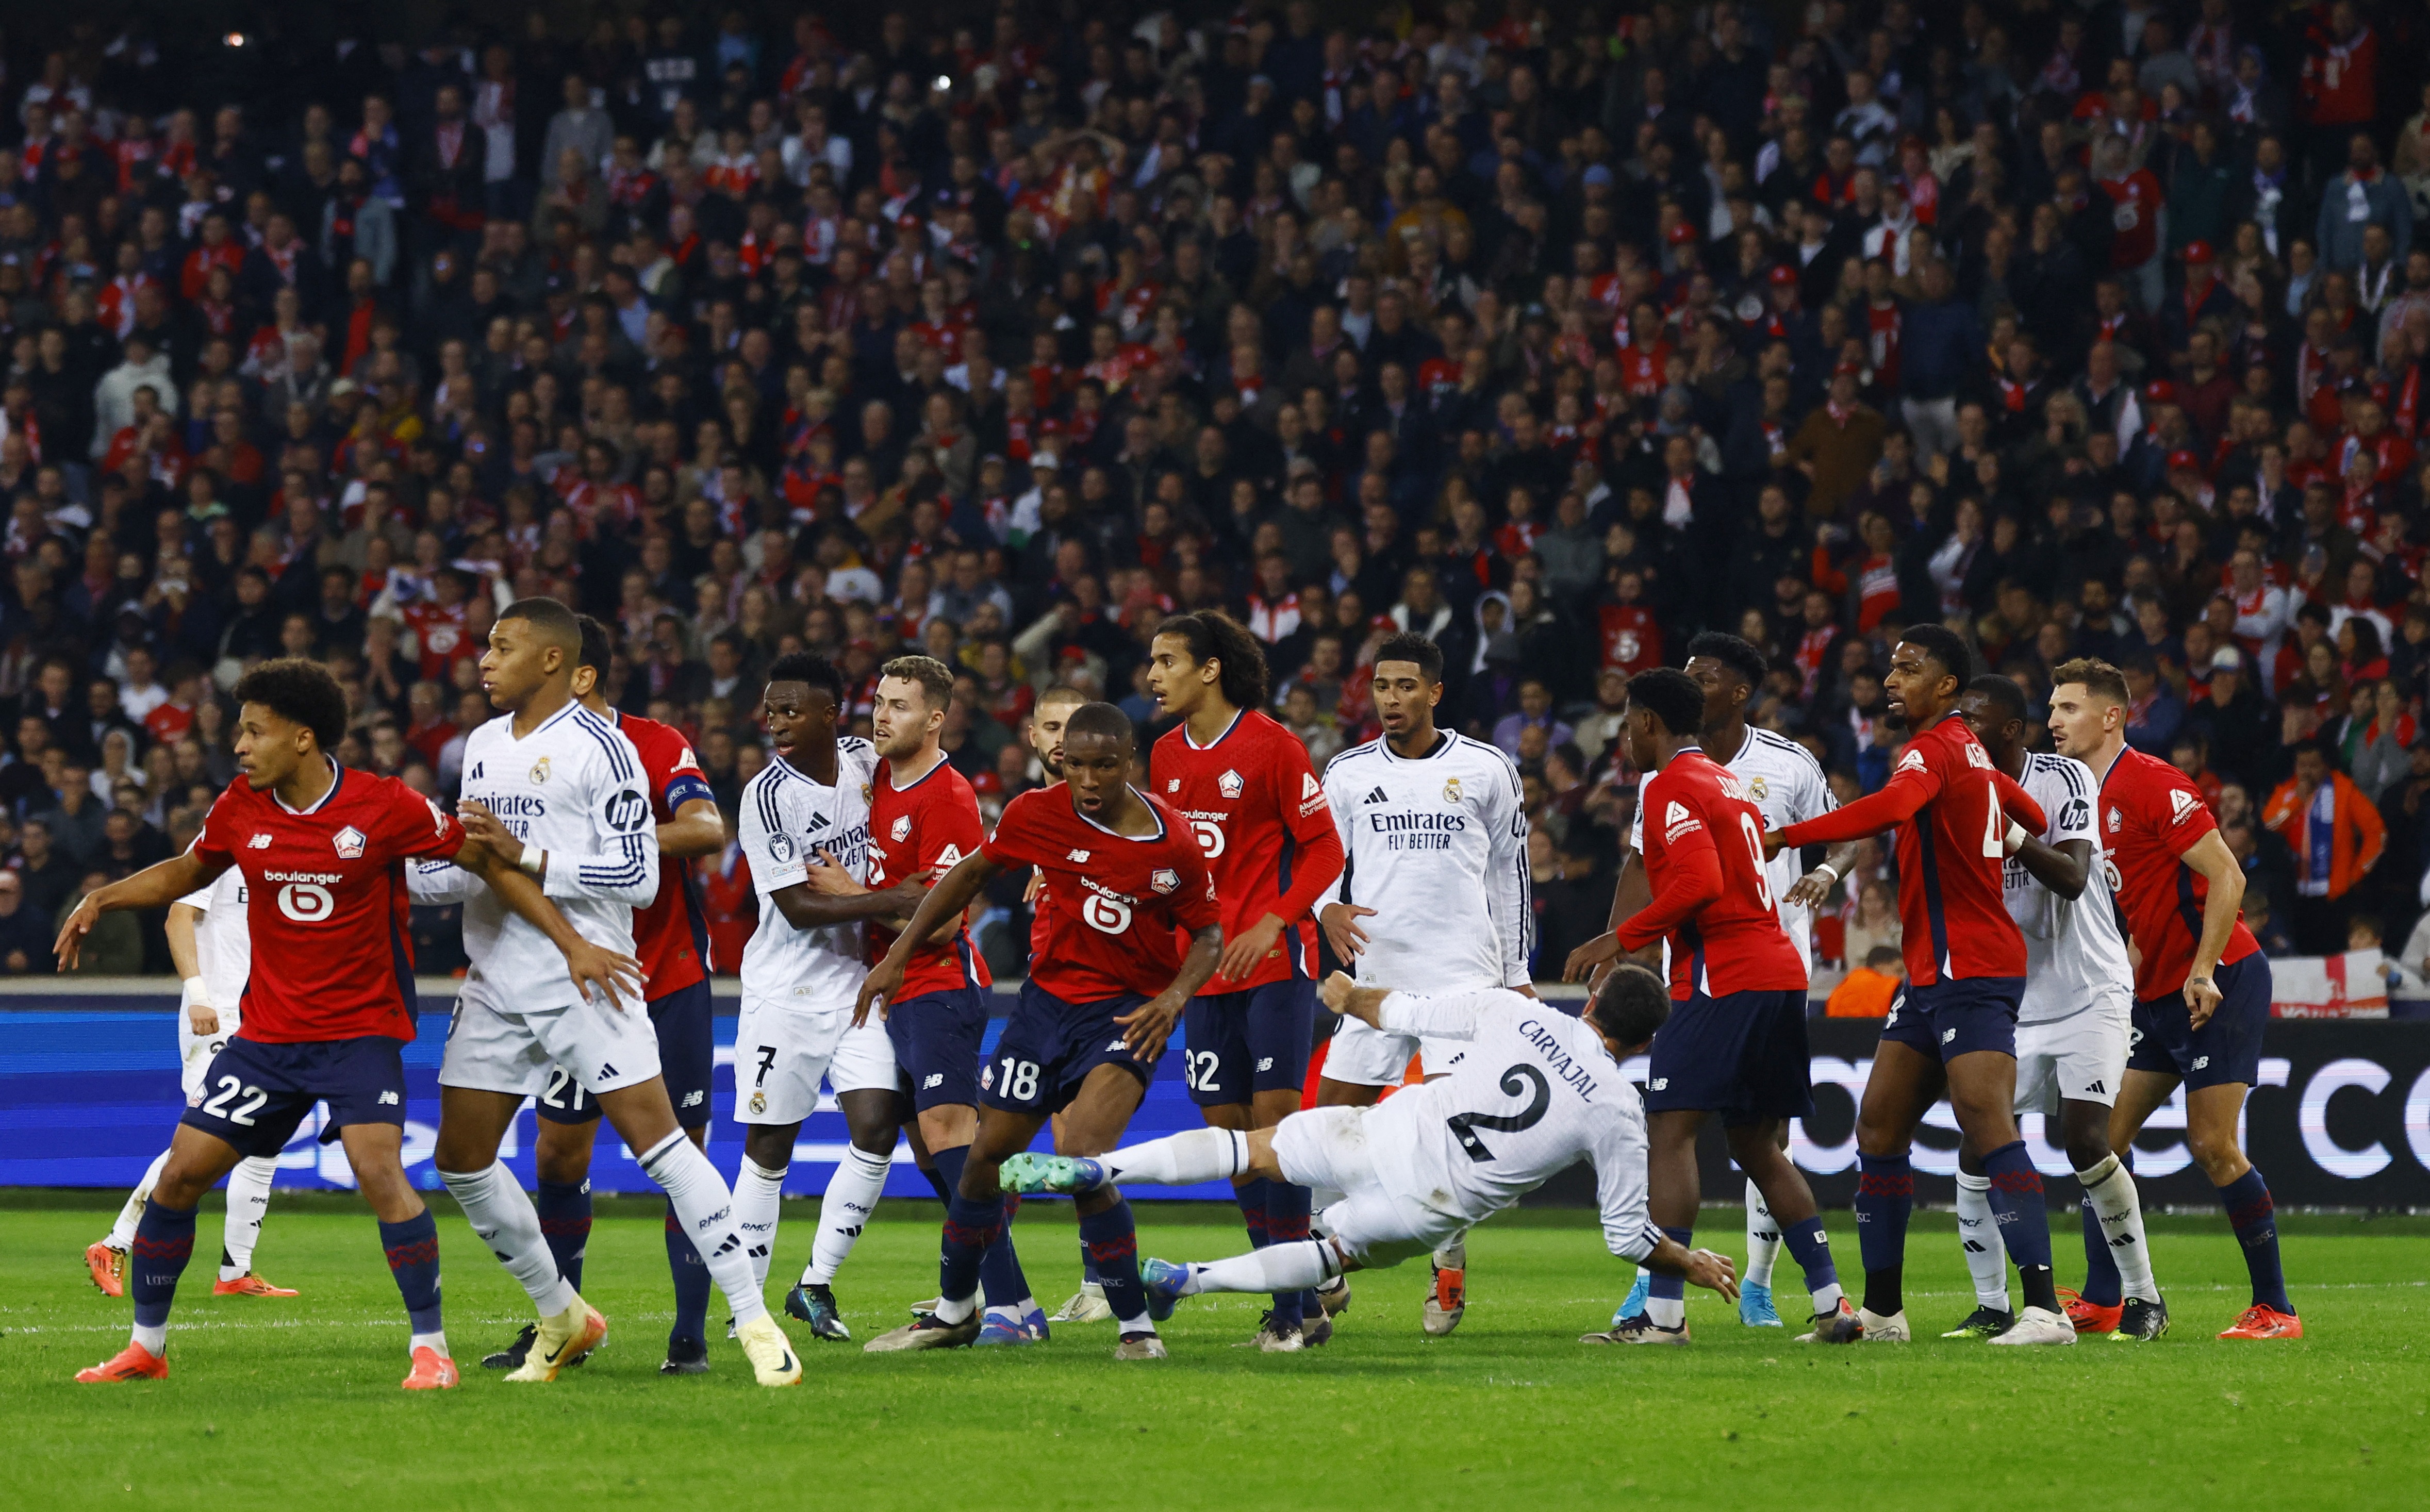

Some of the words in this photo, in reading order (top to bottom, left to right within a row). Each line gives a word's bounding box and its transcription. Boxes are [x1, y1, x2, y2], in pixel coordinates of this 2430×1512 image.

[611, 790, 644, 832] hp
[1180, 809, 1228, 822] oulanger
[1370, 809, 1465, 833] Emirates
[1665, 819, 1700, 839] Aluminium
[247, 833, 273, 850] NB
[811, 821, 869, 857] Emirat
[1388, 834, 1405, 851] FLY
[1409, 833, 1451, 850] BETTER
[1666, 824, 1702, 846] Dunkerque
[778, 846, 786, 855] 15
[1066, 849, 1090, 863] NB
[1740, 811, 1772, 912] 9
[264, 869, 343, 886] boulanger
[756, 1045, 777, 1088] 7
[1186, 1048, 1221, 1092] 32
[1256, 1057, 1274, 1073] NB
[1519, 1020, 1598, 1103] CARVAJAL
[2191, 1055, 2209, 1073] NB
[543, 1062, 587, 1111] 21
[922, 1073, 944, 1090] NB
[999, 1057, 1040, 1101] 18
[1650, 1077, 1668, 1092] NB
[203, 1074, 269, 1127] 22
[377, 1089, 399, 1106] NB
[681, 1090, 704, 1108] NB
[1447, 1063, 1551, 1163] 2
[699, 1204, 731, 1231] RMCF
[1994, 1211, 2020, 1225] OSC
[2101, 1208, 2131, 1225] RMCF
[741, 1222, 773, 1232] RMCF
[1819, 1233, 1825, 1241] 9
[145, 1274, 177, 1286] LOSC
[1098, 1275, 1124, 1288] OSC
